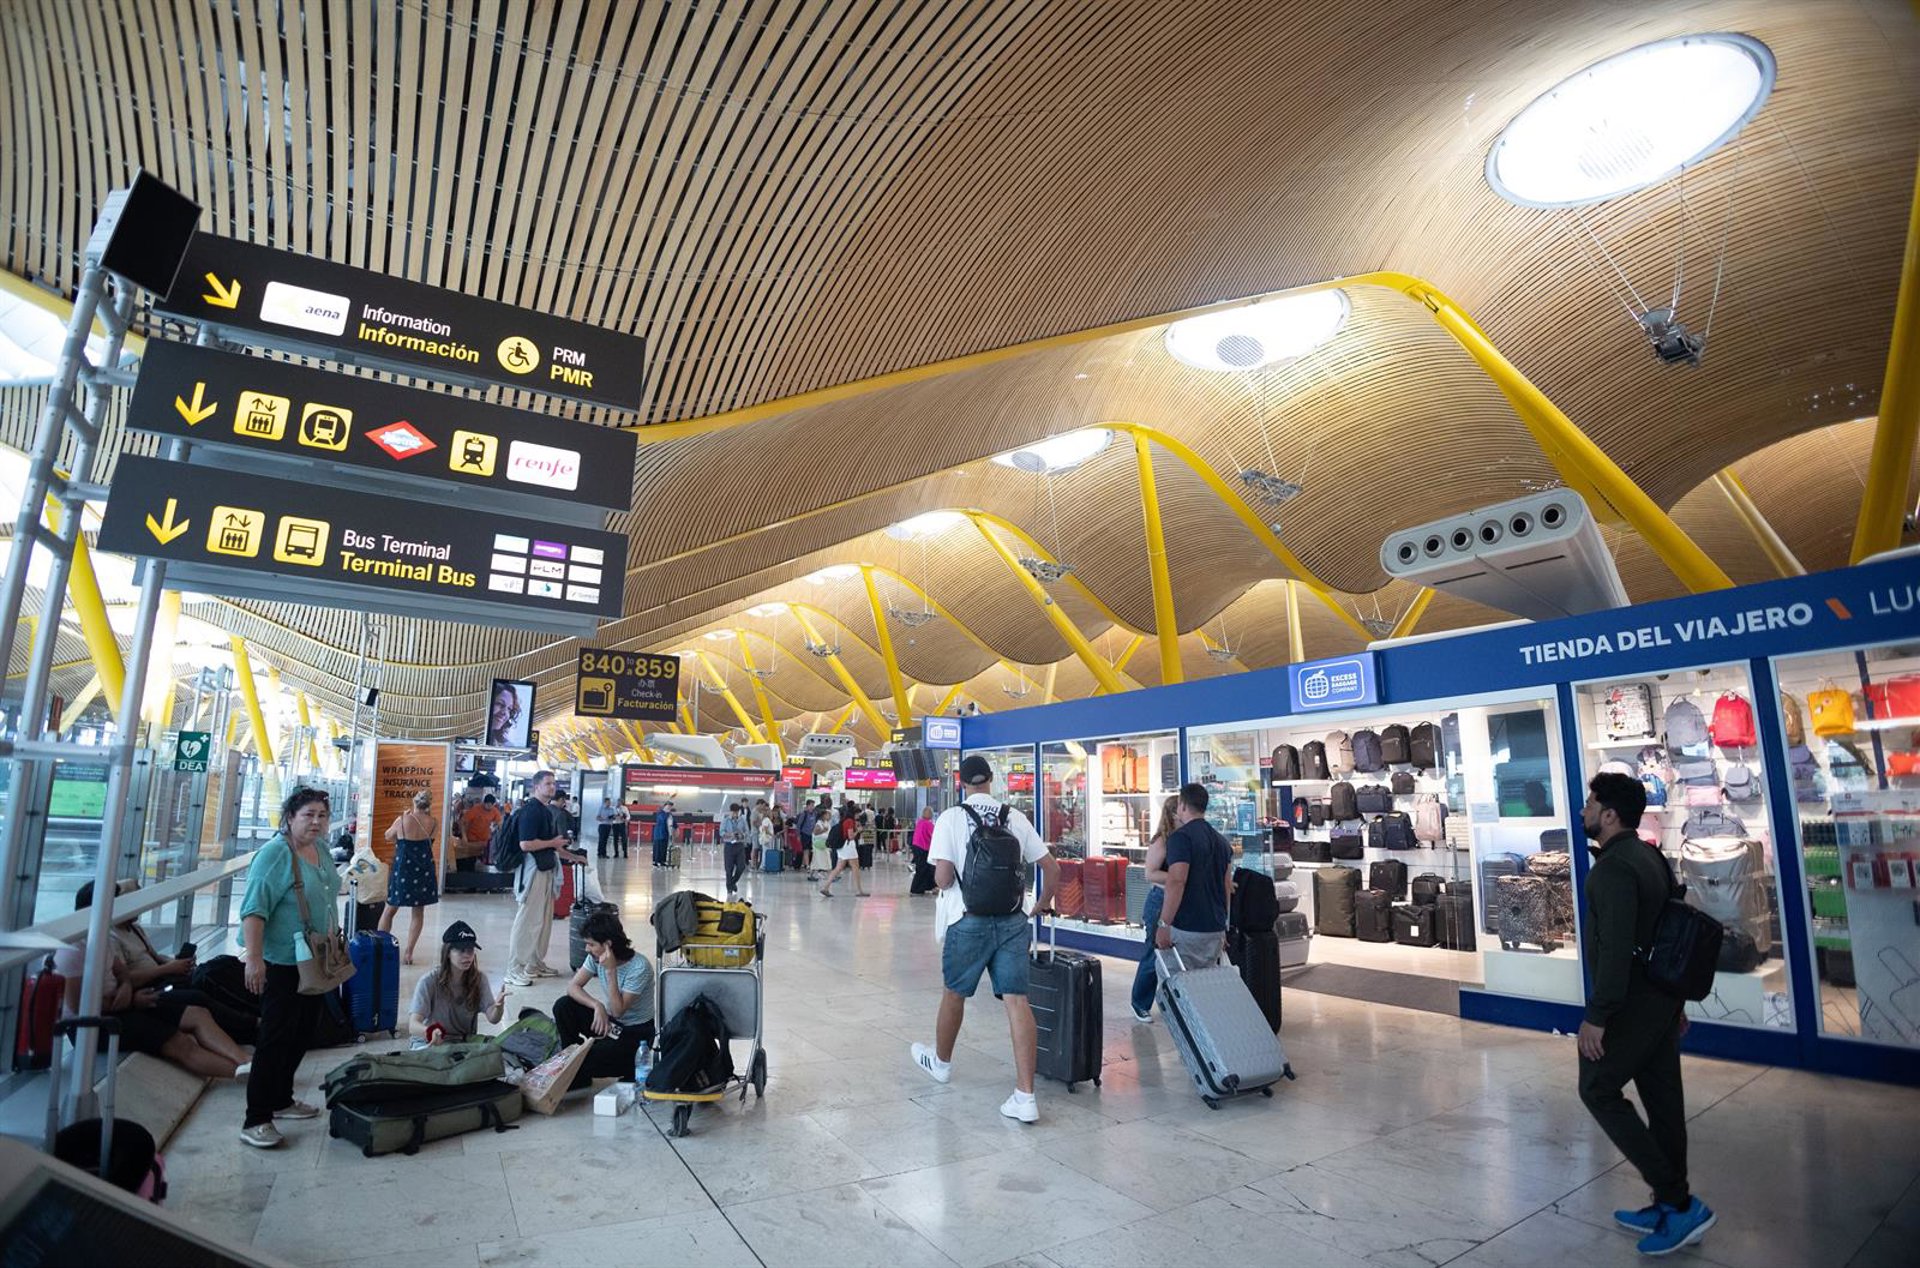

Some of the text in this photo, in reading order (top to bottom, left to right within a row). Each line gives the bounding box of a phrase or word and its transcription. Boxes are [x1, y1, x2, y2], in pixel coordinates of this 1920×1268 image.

[304, 305, 340, 320] aena
[362, 304, 451, 337] Information
[358, 323, 480, 364] Información
[553, 346, 586, 367] PRM
[550, 364, 594, 388] PMR
[514, 454, 573, 477] renfe
[343, 529, 451, 560] Bus Terminal
[340, 551, 476, 587] Terminal Bus
[1519, 585, 1920, 665] TIENDA DEL VIAJERO LU
[581, 653, 625, 675] 840
[635, 658, 677, 679] 859
[617, 698, 674, 711] Facturación
[631, 689, 663, 698] Check-in
[179, 761, 204, 771] DEA
[382, 766, 434, 776] WRAPPING
[383, 778, 432, 788] INSURANCE
